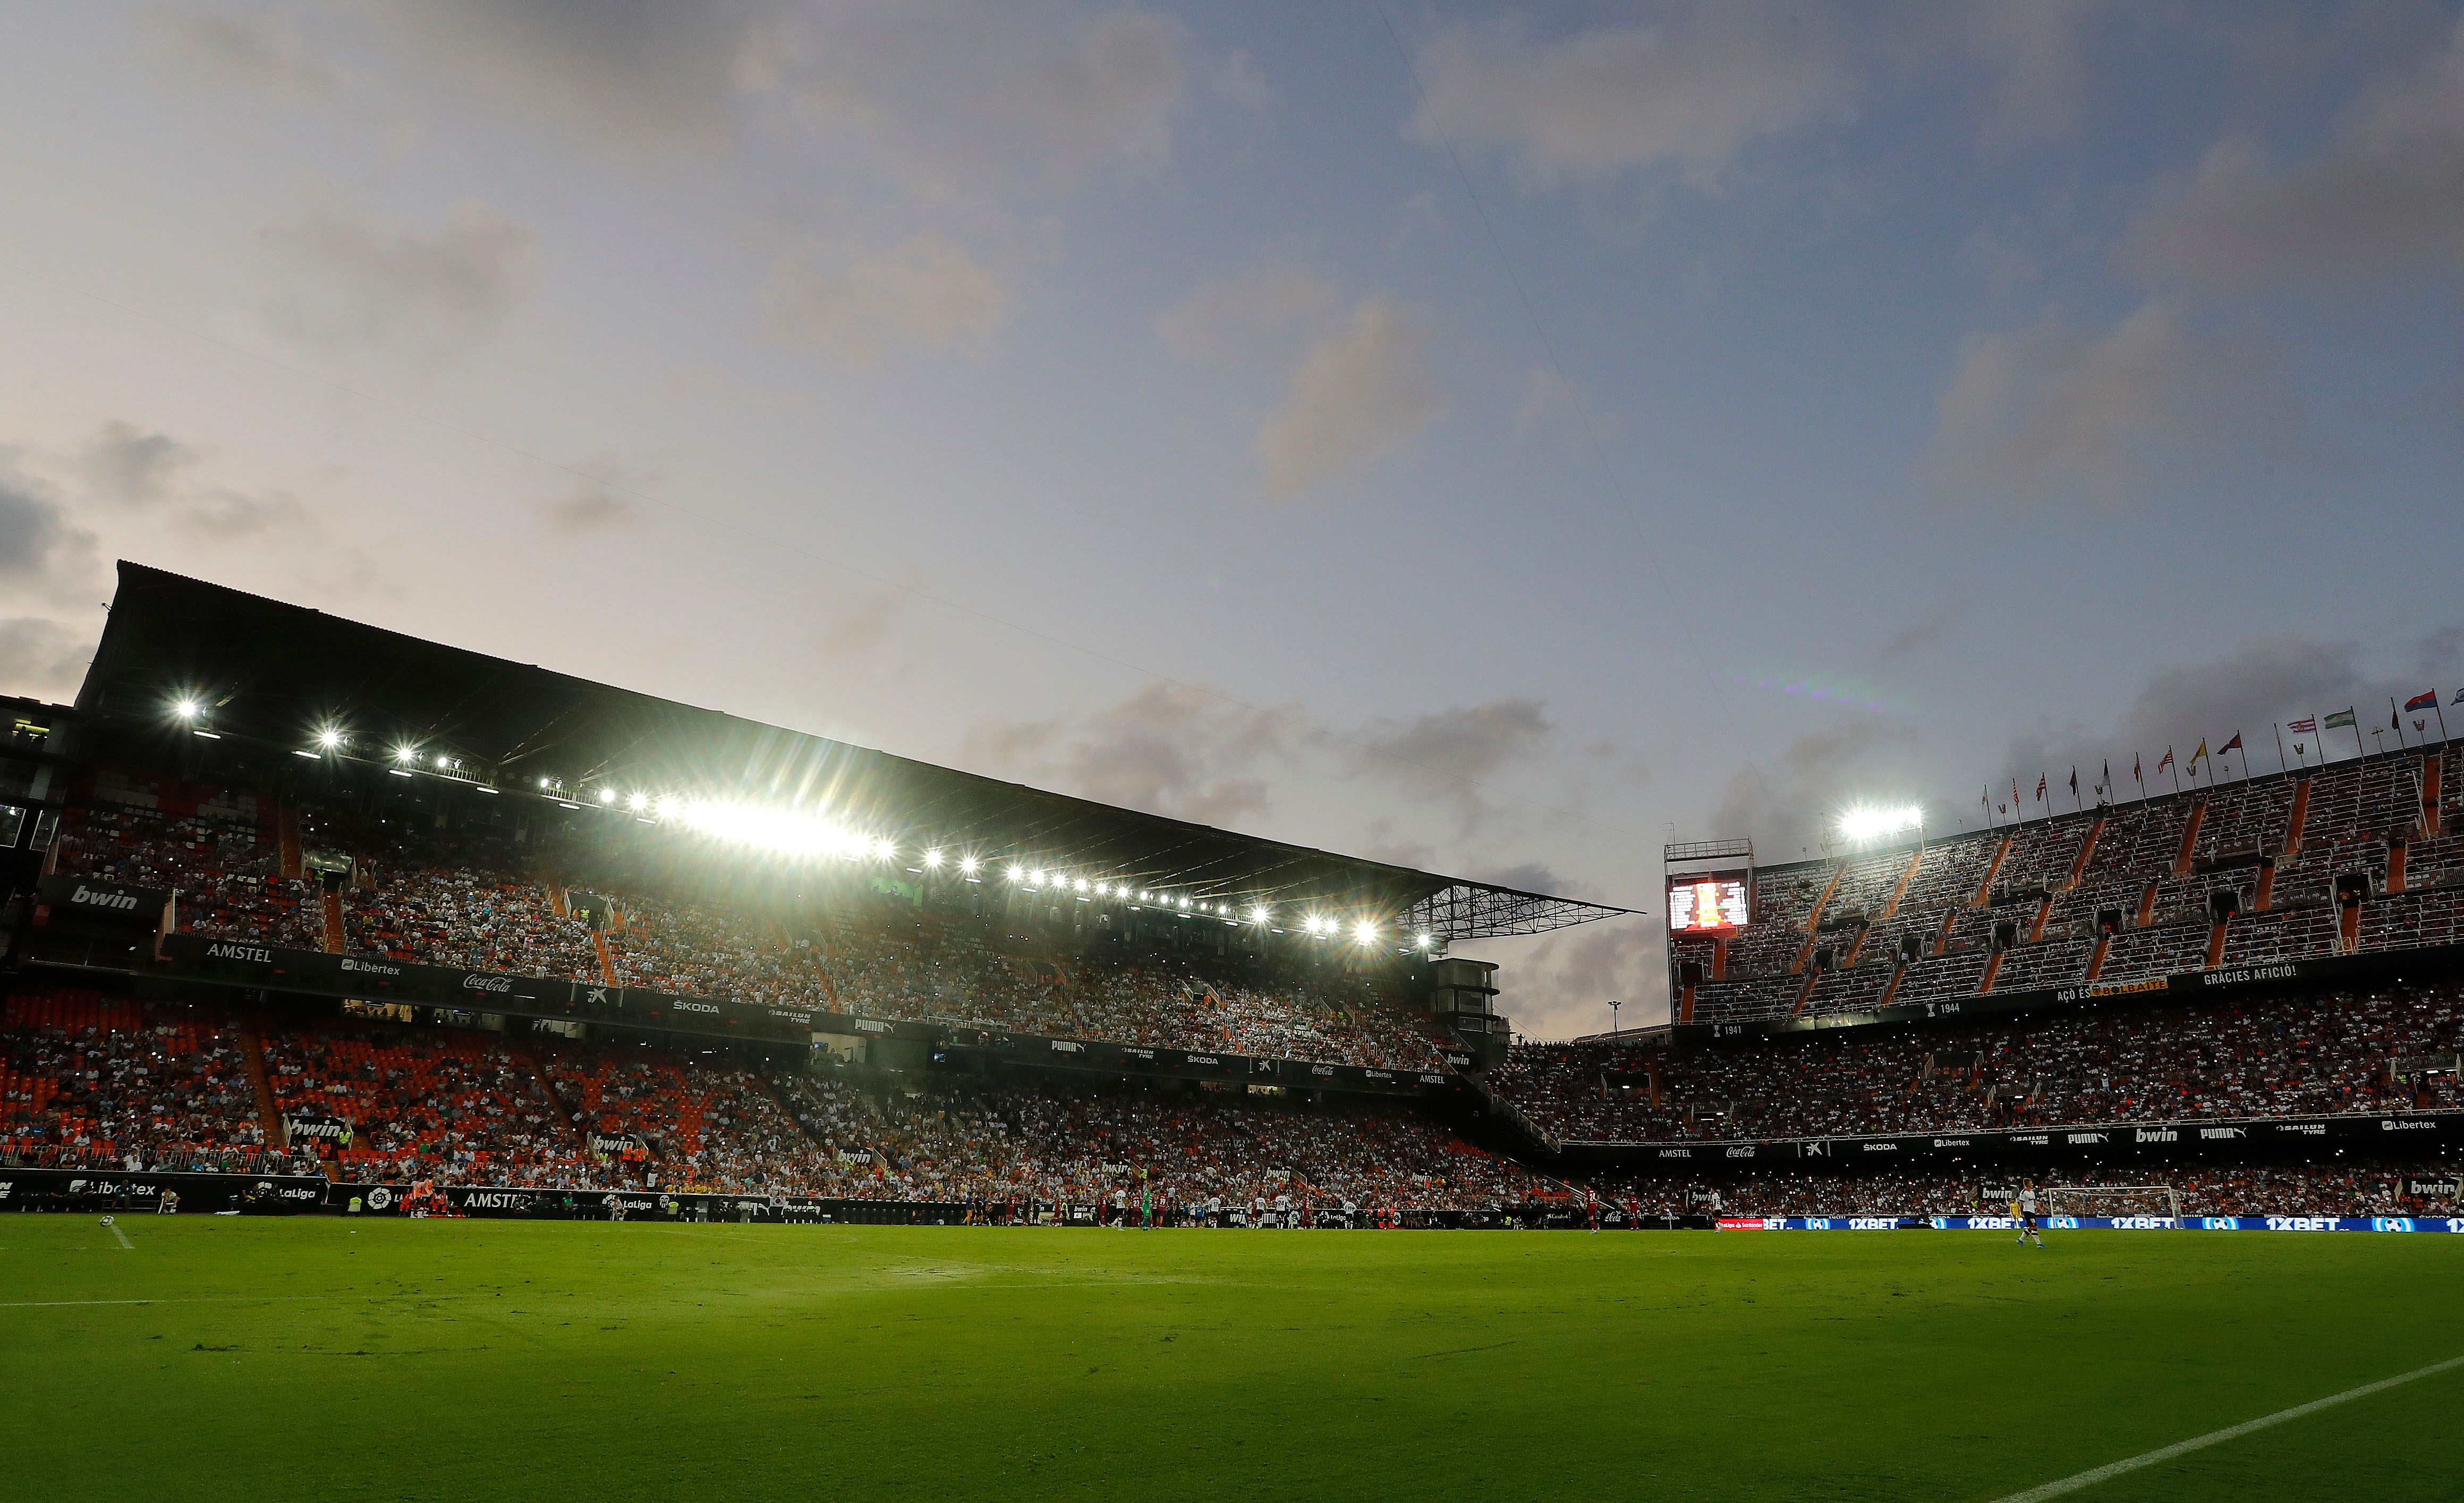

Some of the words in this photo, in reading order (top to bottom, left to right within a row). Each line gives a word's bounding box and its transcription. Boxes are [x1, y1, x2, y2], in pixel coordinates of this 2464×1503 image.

[71, 885, 138, 910] bwin
[207, 944, 272, 963] AMSTEL
[353, 960, 401, 976] Libertex
[2204, 971, 2250, 985] GRÀCIES
[2255, 964, 2297, 979] AFICIÓ!
[2103, 980, 2166, 995] BLBAITE
[2058, 988, 2076, 1003] AÇÒ
[2079, 987, 2091, 999] ÉS
[673, 1000, 720, 1014] ŠKODA
[1941, 1003, 1960, 1014] 1944
[775, 1010, 811, 1018] SAILUN
[855, 1019, 884, 1032] PUMA
[1724, 1026, 1741, 1034] 1941
[1052, 1040, 1076, 1052] PUMA
[1187, 1055, 1218, 1065] ŠKODA
[1448, 1054, 1469, 1065] bwin
[1420, 1075, 1445, 1084] AMSTEL
[292, 1119, 341, 1137] bwin
[2393, 1120, 2436, 1130] Libertex
[2068, 1134, 2098, 1144] PUMA
[2136, 1127, 2178, 1142] bwin
[2200, 1128, 2234, 1139] PUMA
[593, 1135, 633, 1151] bwin
[838, 1148, 871, 1164] bwin
[1102, 1161, 1128, 1173] bwin
[1267, 1166, 1290, 1178] bwin
[90, 1181, 155, 1195] Libtex
[279, 1188, 316, 1199] LaLiga
[1983, 1186, 2012, 1199] bwin
[2411, 1180, 2455, 1194] bwin
[464, 1193, 518, 1208] AMSTE
[1692, 1191, 1712, 1201] bwi
[623, 1200, 652, 1209] LaLiga
[1849, 1218, 1899, 1230] 1XBET
[2111, 1217, 2175, 1230] 1XBET
[2266, 1218, 2340, 1231] 1XBET
